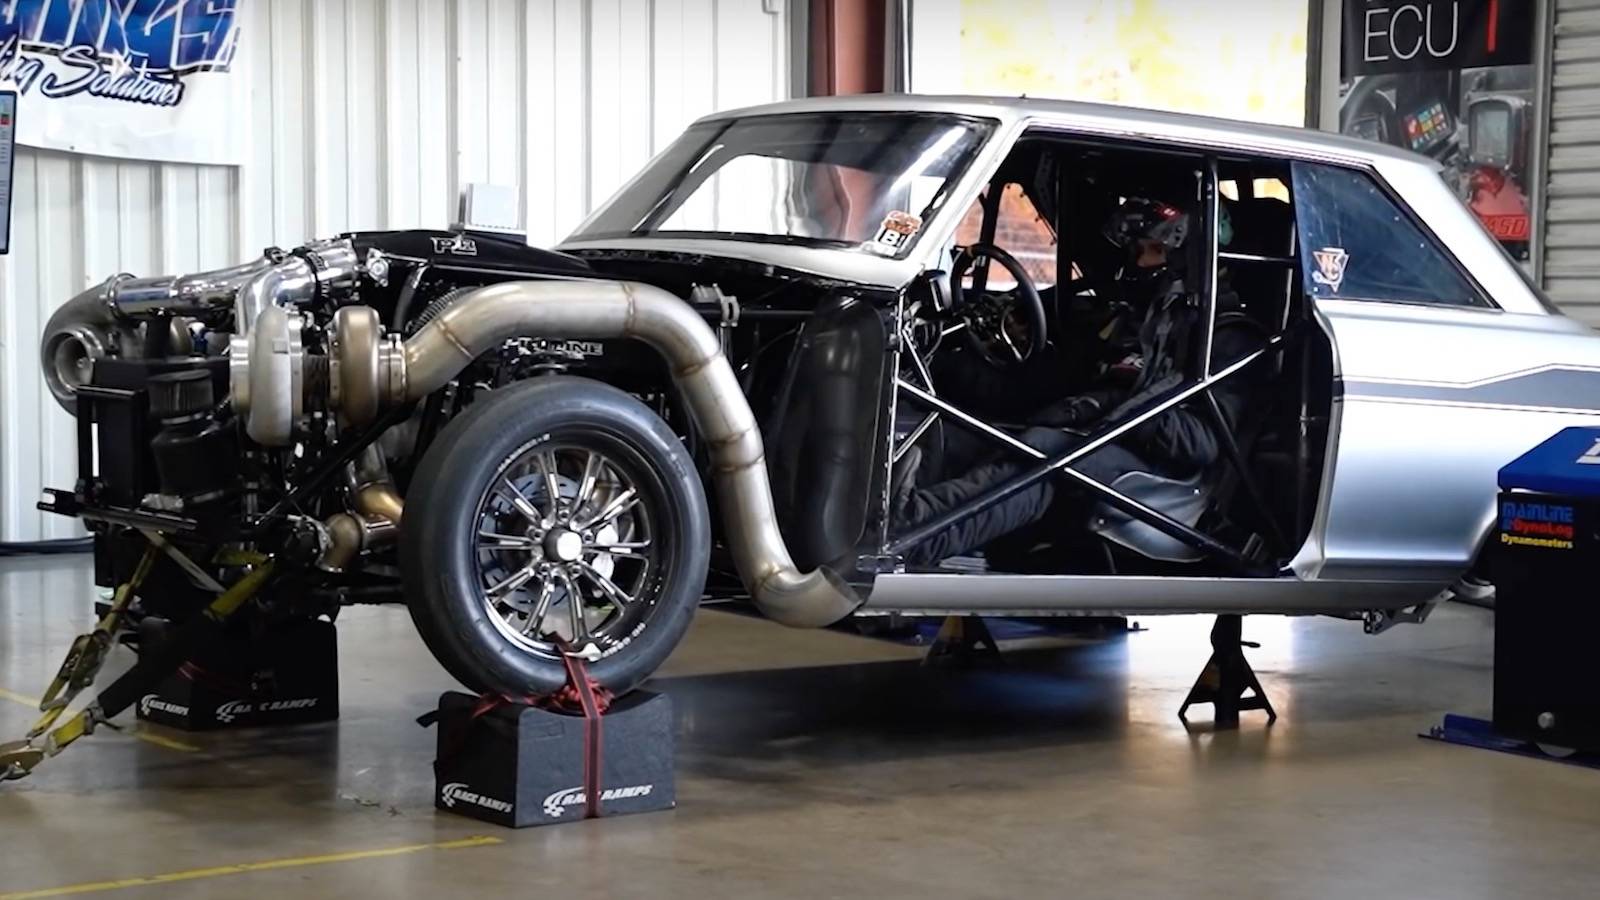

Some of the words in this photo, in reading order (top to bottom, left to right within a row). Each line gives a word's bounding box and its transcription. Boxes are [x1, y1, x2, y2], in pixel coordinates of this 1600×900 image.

[1363, 2, 1459, 62] ECU
[41, 44, 186, 106] Solutions
[1502, 502, 1574, 523] MAINLINE
[1501, 533, 1574, 549] Dynamometers
[269, 698, 318, 710] RAMPS
[453, 788, 480, 804] RACE
[478, 796, 514, 813] RAMPS
[601, 784, 653, 801] RAMPS
